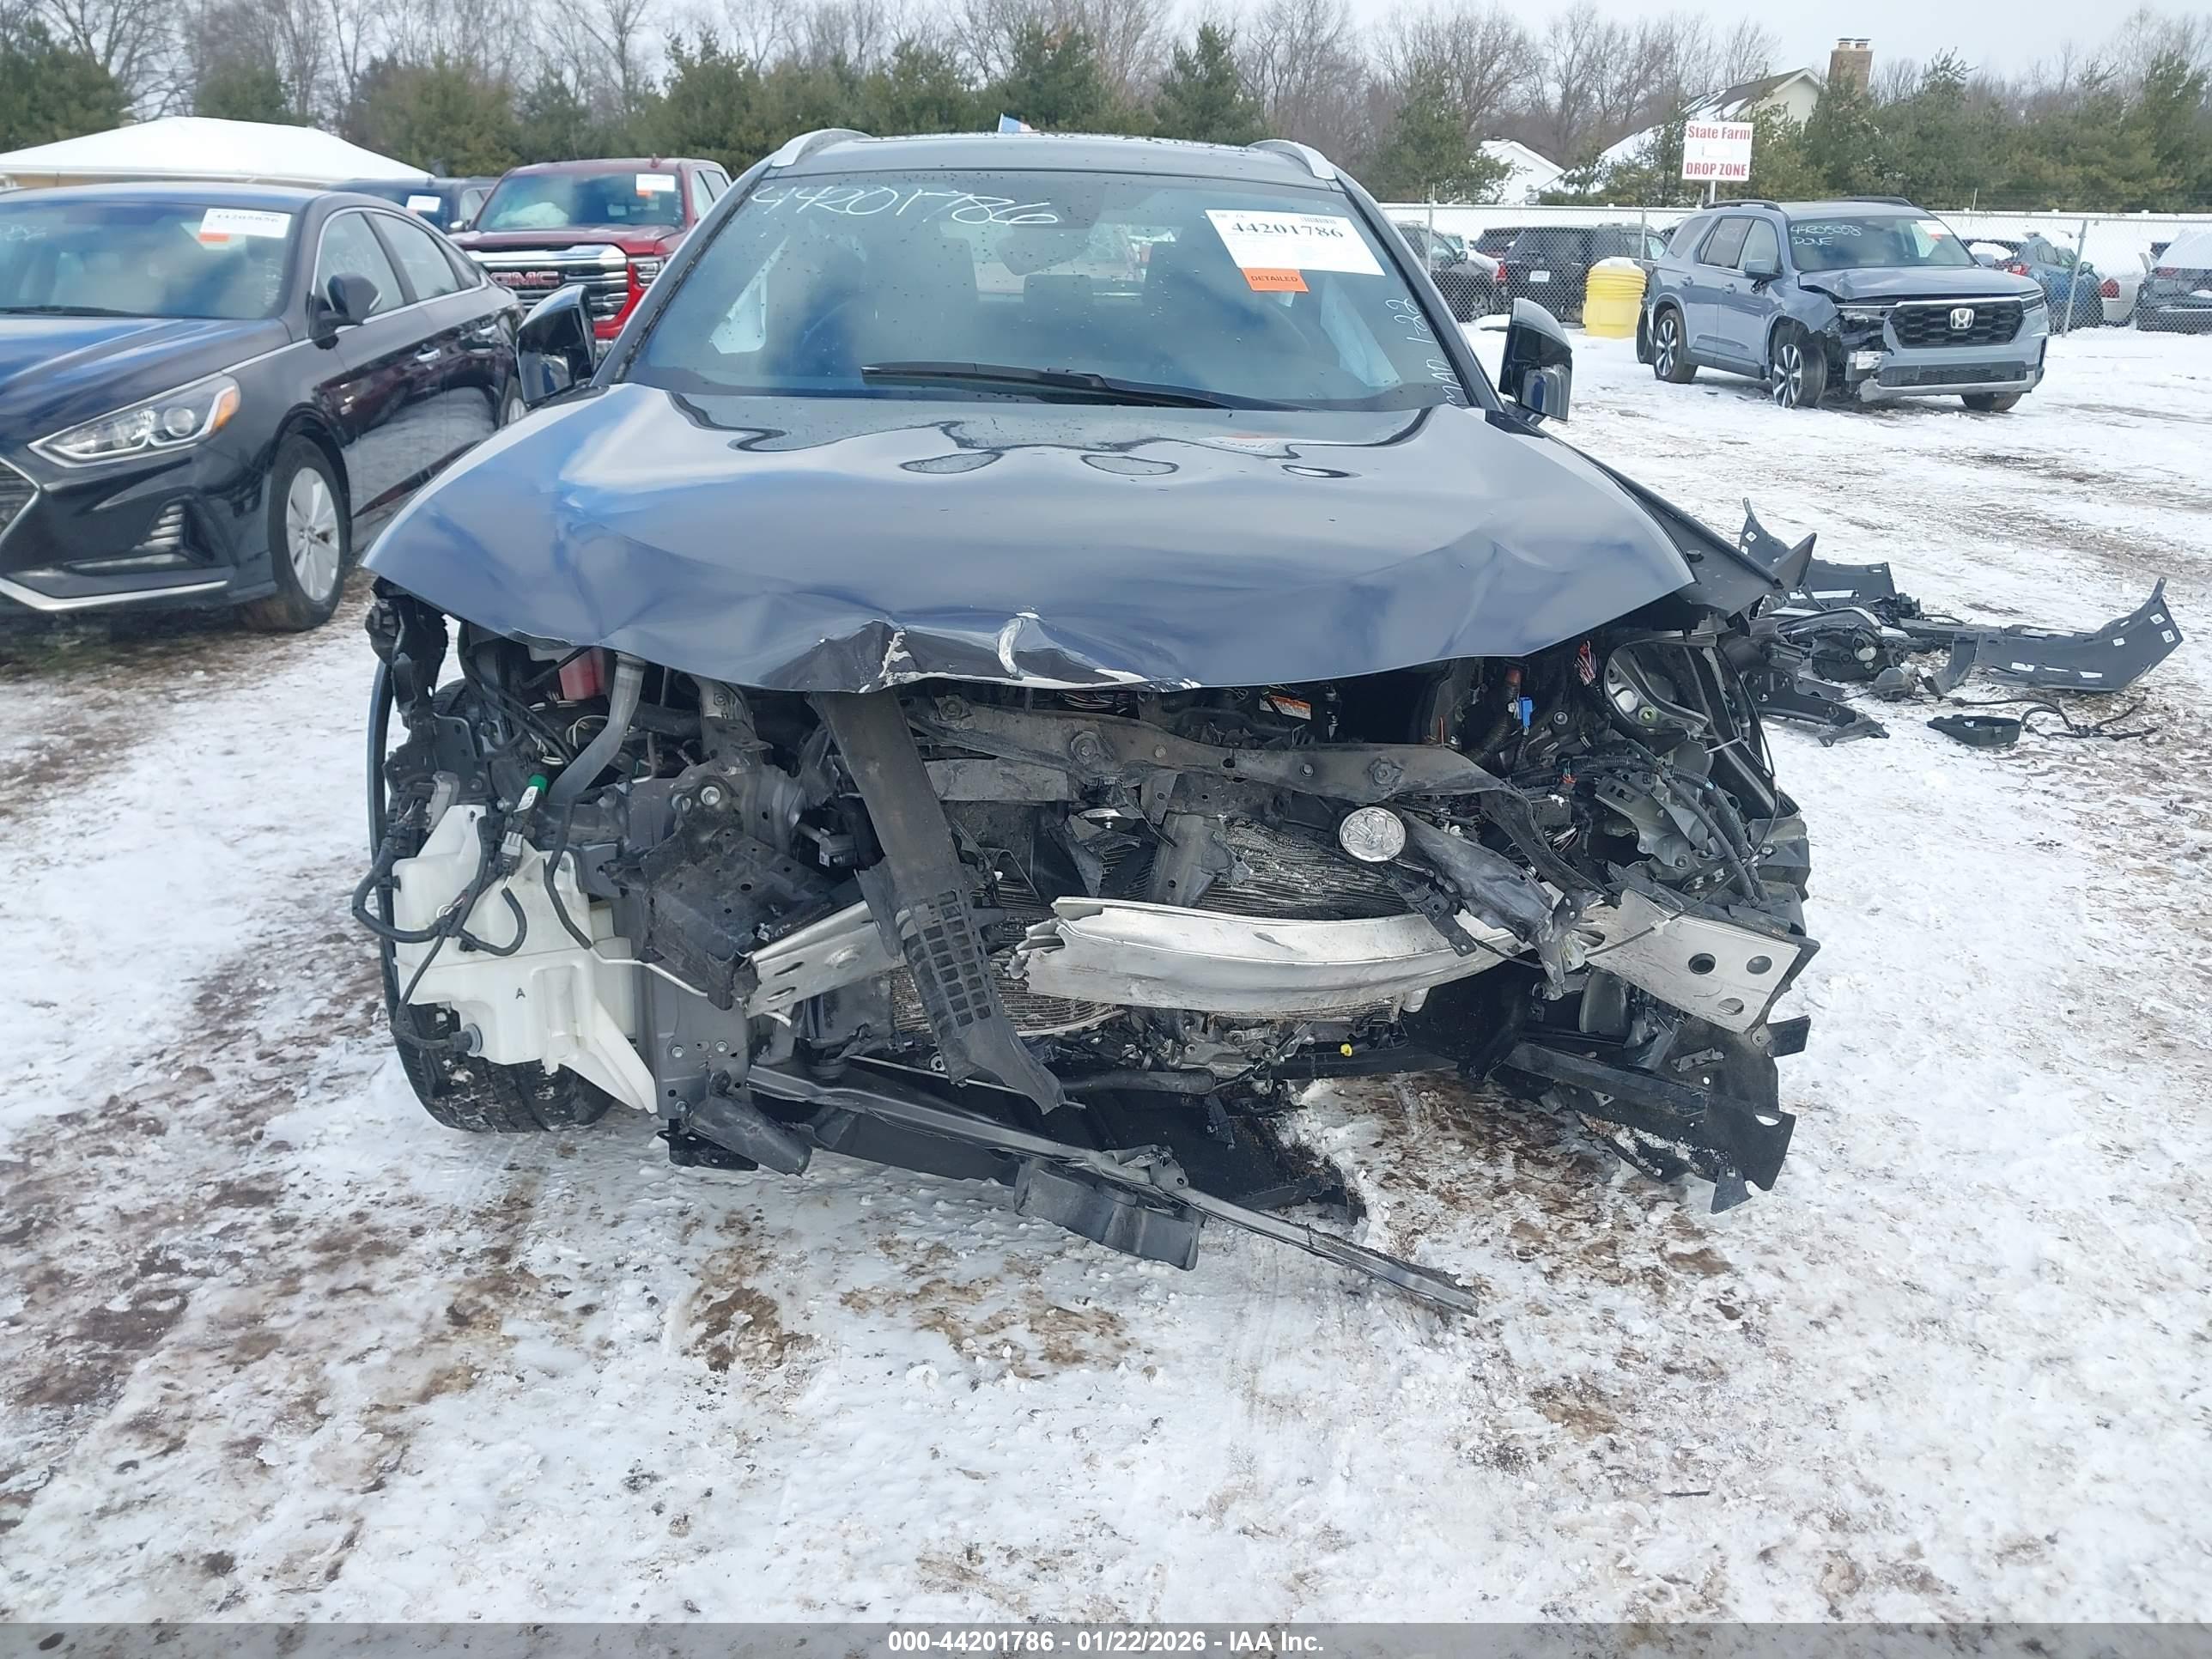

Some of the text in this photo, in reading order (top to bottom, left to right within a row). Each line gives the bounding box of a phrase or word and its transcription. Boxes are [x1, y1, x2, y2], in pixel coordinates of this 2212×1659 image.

[1687, 125, 1751, 140] State Farm
[1686, 161, 1747, 176] DROP ZONE
[750, 186, 1059, 225] 44201786
[1231, 222, 1344, 239] 44201786
[1792, 236, 1834, 246] DONE
[490, 270, 560, 286] GMC
[515, 988, 526, 999] A
